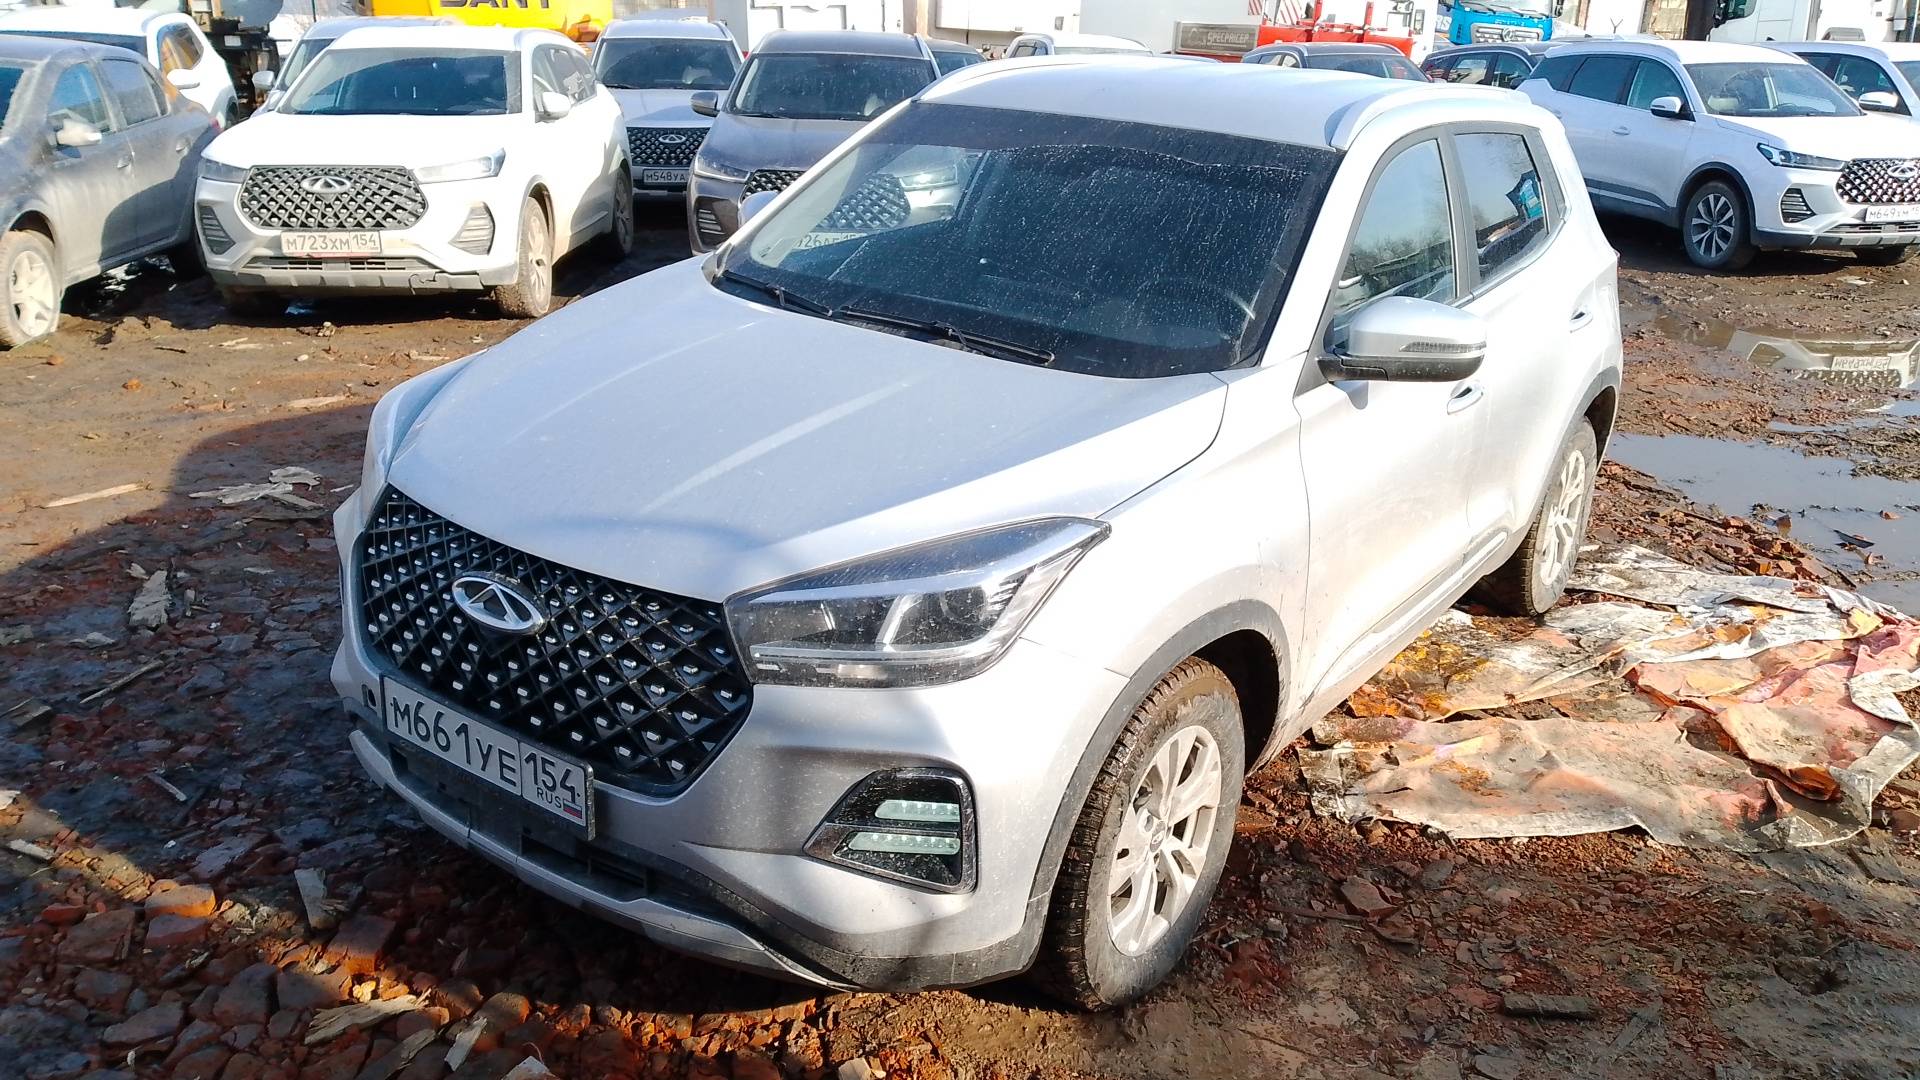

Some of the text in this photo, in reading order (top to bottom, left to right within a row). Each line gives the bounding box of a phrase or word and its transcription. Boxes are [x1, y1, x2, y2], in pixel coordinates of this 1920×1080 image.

[286, 233, 377, 250] М723ХМ 154
[393, 696, 576, 804] М661УЕ 154
[536, 786, 562, 809] RUS
